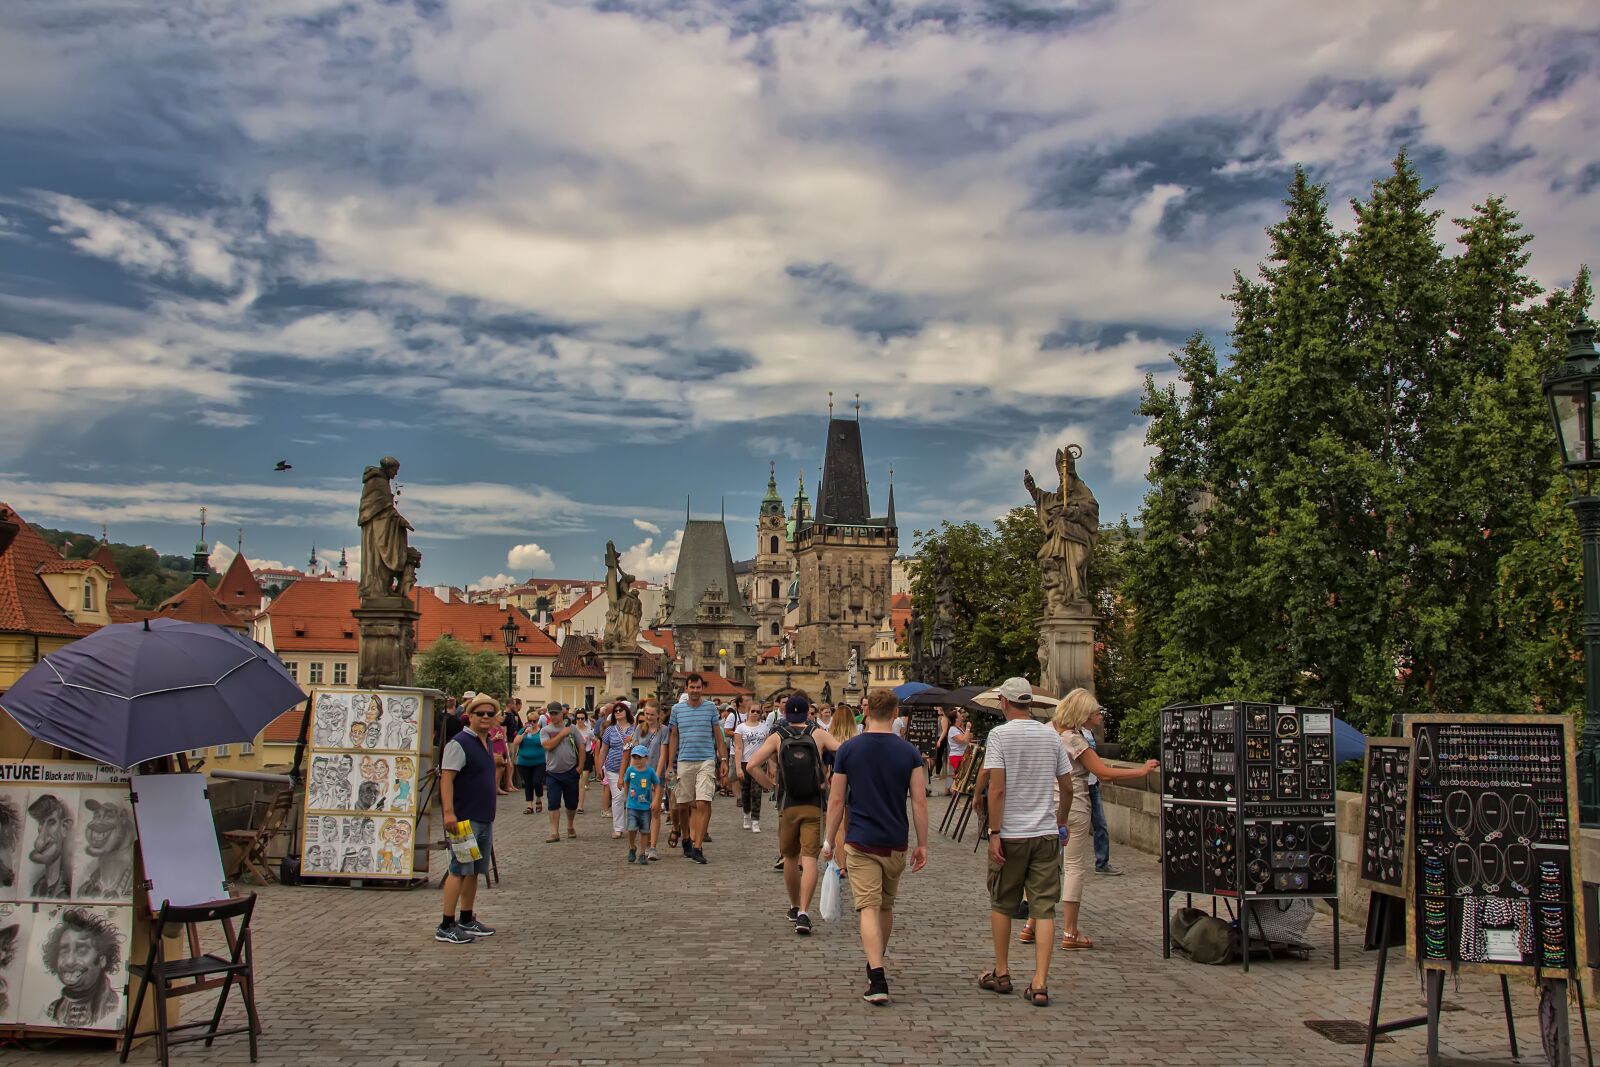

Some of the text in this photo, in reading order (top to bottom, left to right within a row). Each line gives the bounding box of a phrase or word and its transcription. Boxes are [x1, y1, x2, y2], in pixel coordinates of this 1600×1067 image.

[45, 771, 94, 781] Black and White
